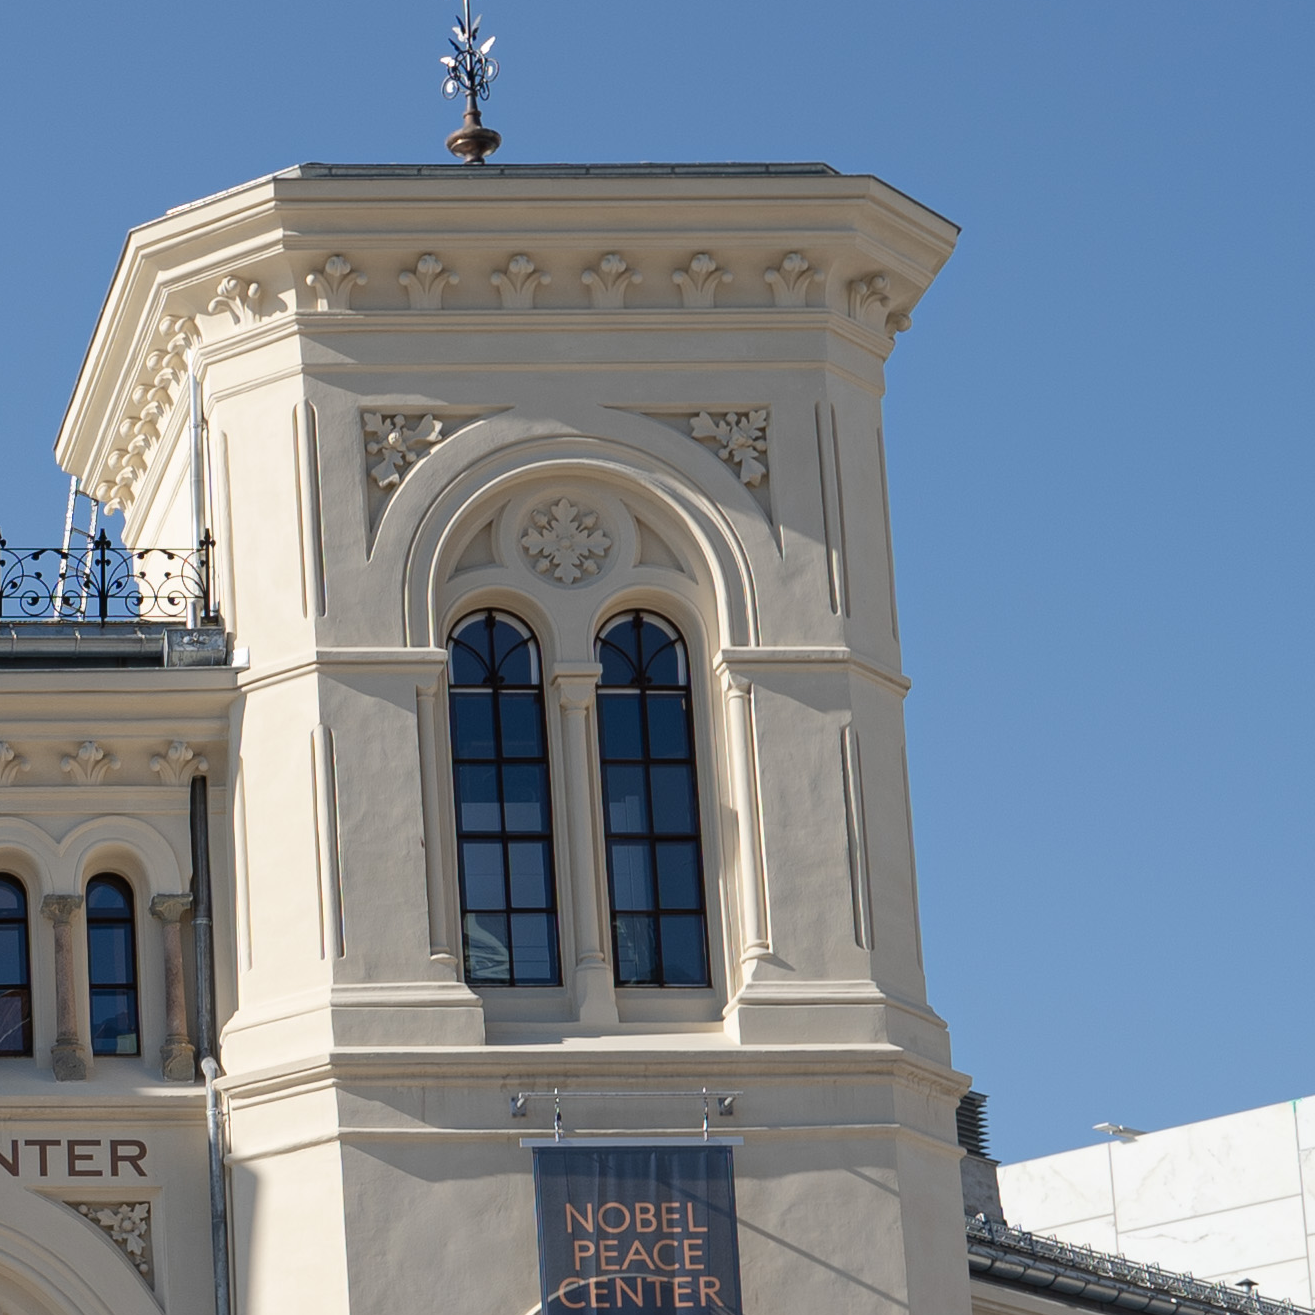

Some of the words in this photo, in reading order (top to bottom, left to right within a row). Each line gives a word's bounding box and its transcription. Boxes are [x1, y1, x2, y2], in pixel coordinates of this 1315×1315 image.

[565, 1202, 708, 1233] NOBEL
[573, 1239, 705, 1271] PEACE
[558, 1276, 724, 1308] CENTER
